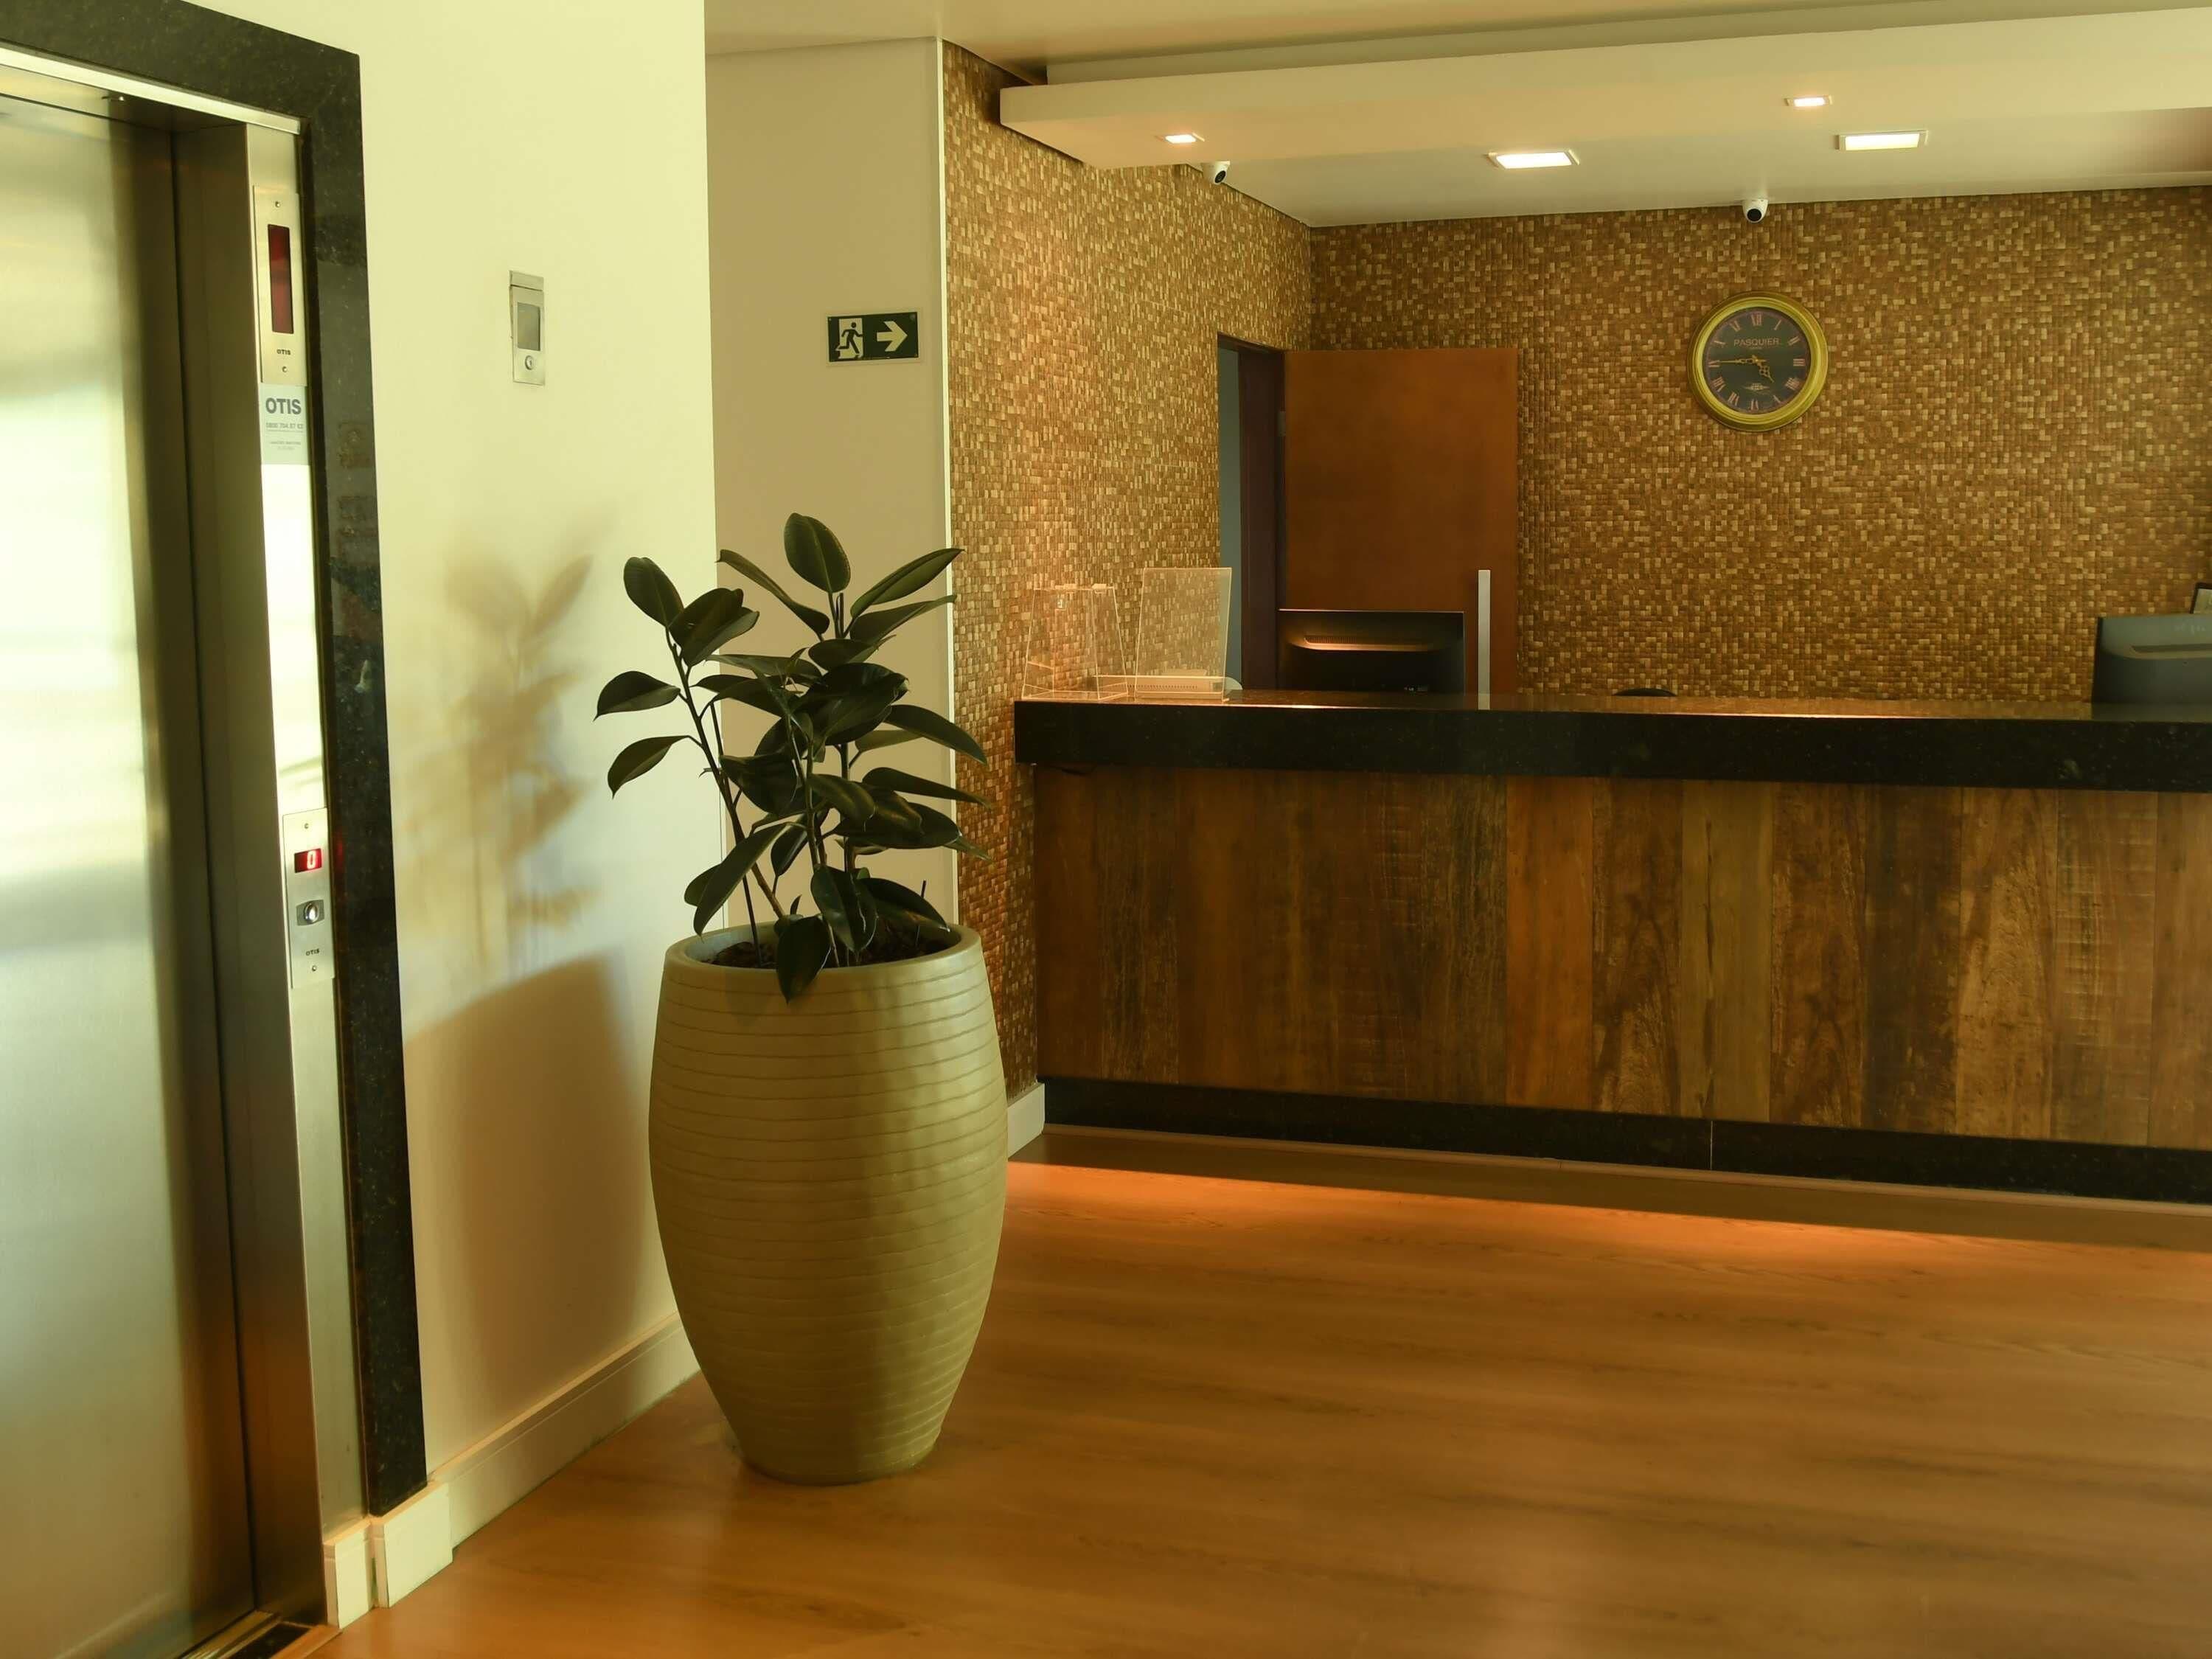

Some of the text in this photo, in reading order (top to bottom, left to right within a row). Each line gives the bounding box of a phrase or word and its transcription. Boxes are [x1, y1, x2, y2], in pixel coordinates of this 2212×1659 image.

[1733, 337, 1780, 347] PASQUIER
[265, 397, 302, 414] OTIS
[307, 850, 316, 869] 0
